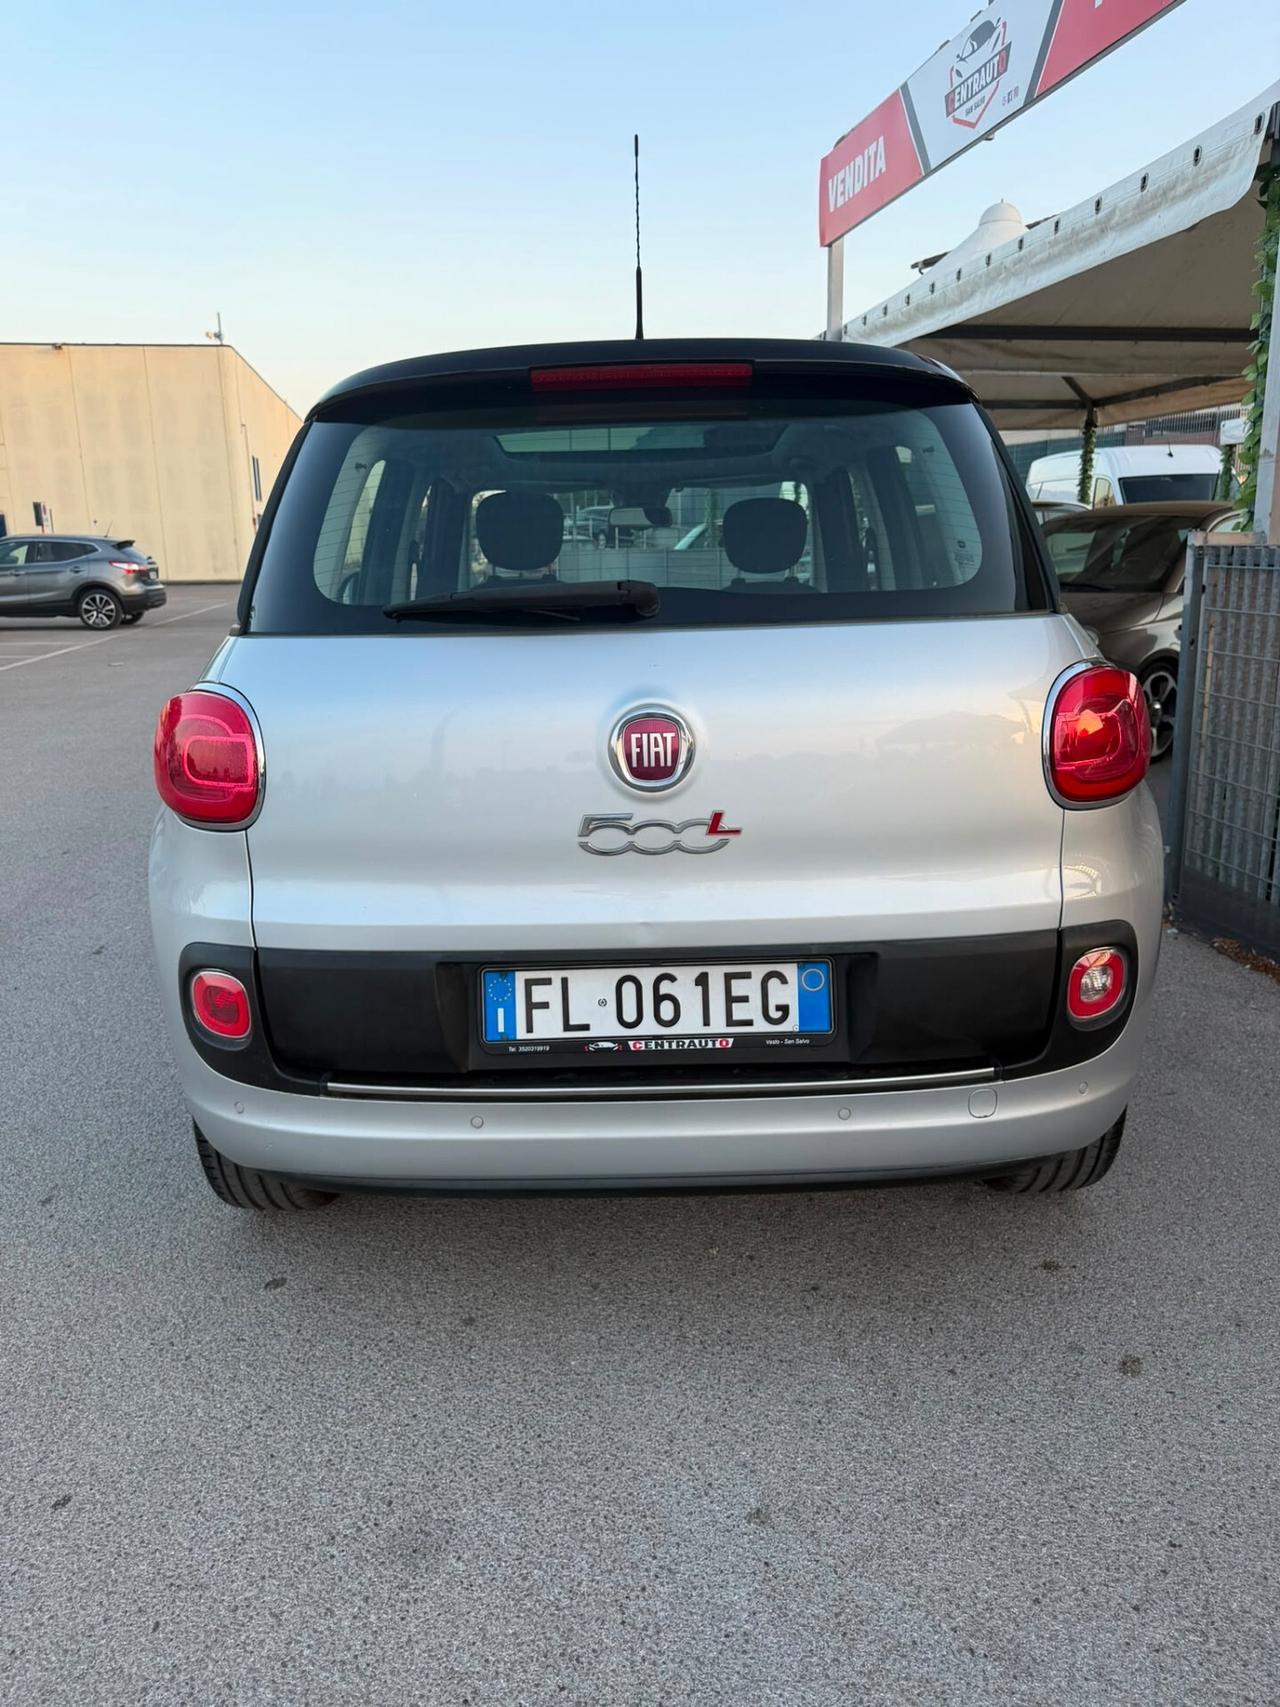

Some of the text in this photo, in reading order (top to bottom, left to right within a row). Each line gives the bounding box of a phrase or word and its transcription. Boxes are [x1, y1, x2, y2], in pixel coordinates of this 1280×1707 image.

[947, 49, 1007, 115] CENTRAUTO
[828, 135, 886, 213] VENDITA
[630, 732, 676, 768] FIAT
[524, 976, 591, 1034] FL
[632, 1038, 730, 1050] CENTRAUTO
